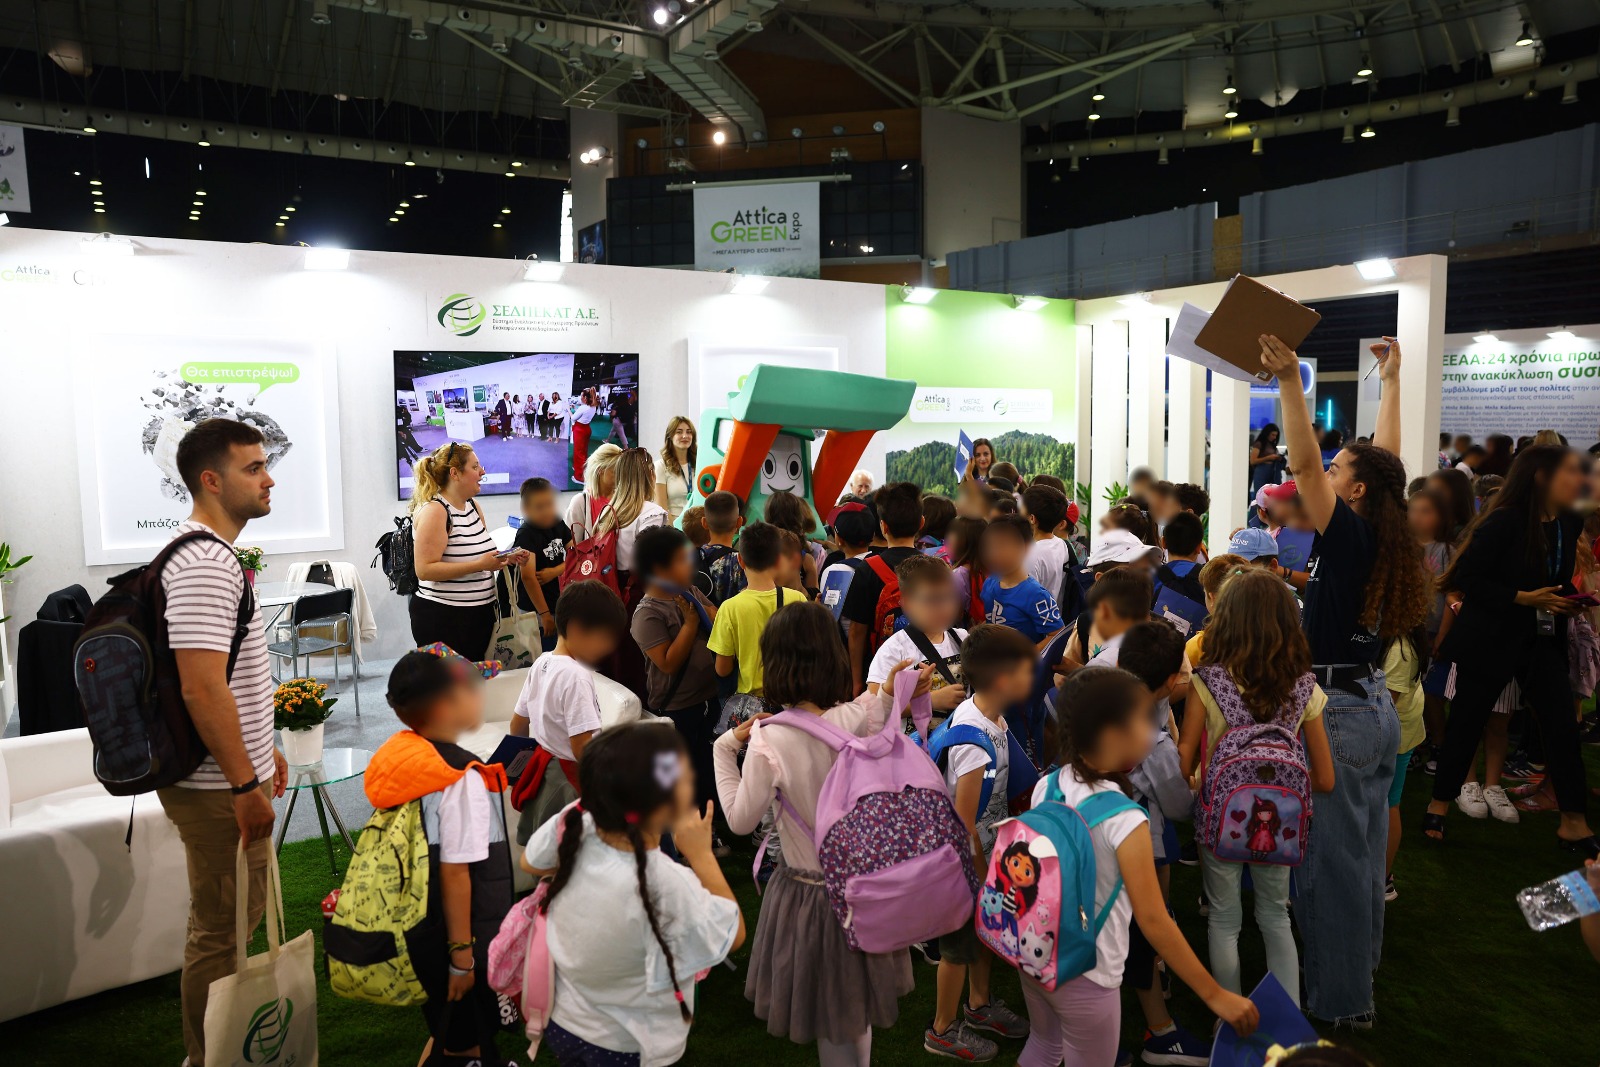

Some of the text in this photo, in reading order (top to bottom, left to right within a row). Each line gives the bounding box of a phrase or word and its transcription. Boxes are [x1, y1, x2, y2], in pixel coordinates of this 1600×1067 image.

[732, 206, 787, 226] Attica
[710, 221, 787, 243] GREEN
[789, 212, 802, 241] Expo
[15, 265, 50, 275] Attica
[492, 304, 599, 320] ΣΕΔΠΕΚΑΤ Α.Ε.
[1509, 349, 1563, 366] χρόνια
[186, 366, 293, 380] Θα επιστρέψω!
[1471, 368, 1553, 381] ανακύκλωση
[1490, 385, 1506, 394] μαζί
[1540, 384, 1571, 392] πολίτες
[924, 394, 946, 404] Attica
[137, 518, 180, 529] Μπάζα
